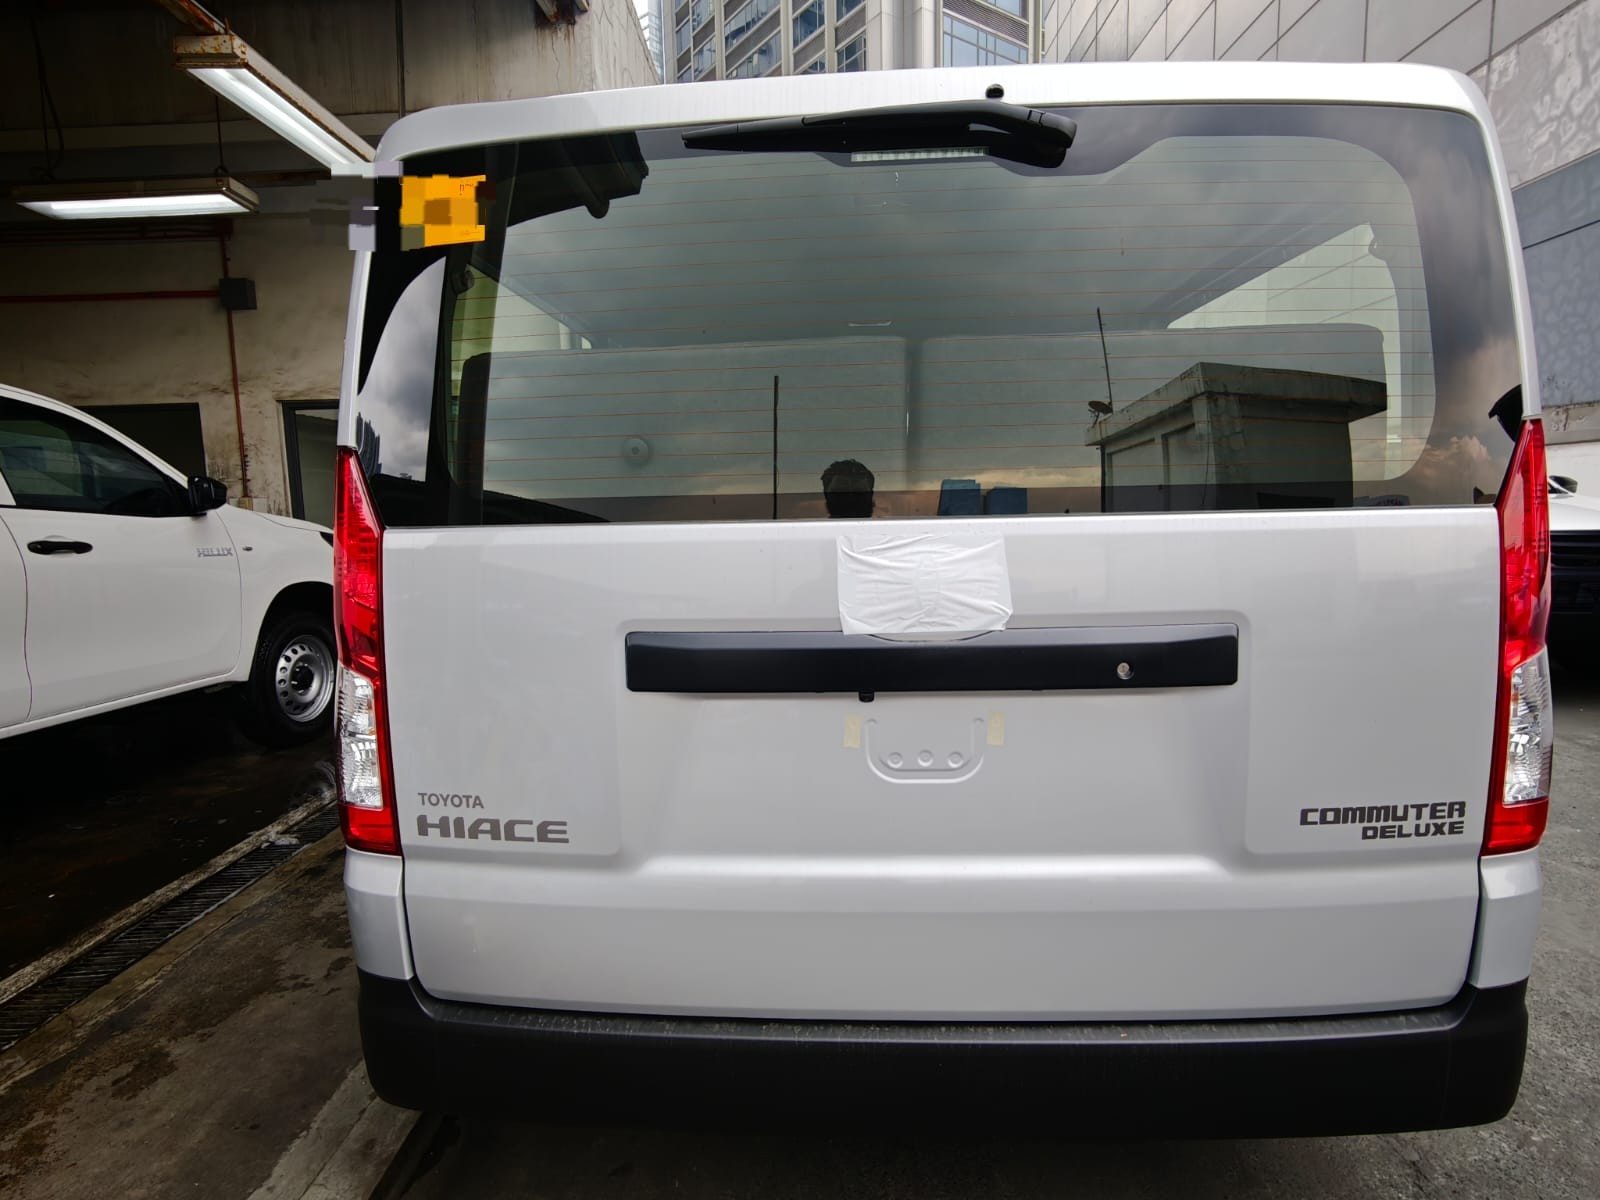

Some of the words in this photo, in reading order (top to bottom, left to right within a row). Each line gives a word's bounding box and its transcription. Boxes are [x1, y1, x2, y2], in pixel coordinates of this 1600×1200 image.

[417, 792, 484, 809] TOYOTA
[1299, 800, 1467, 826] COMMUTER
[416, 814, 570, 844] HIACE
[1361, 820, 1465, 841] DELUXE
